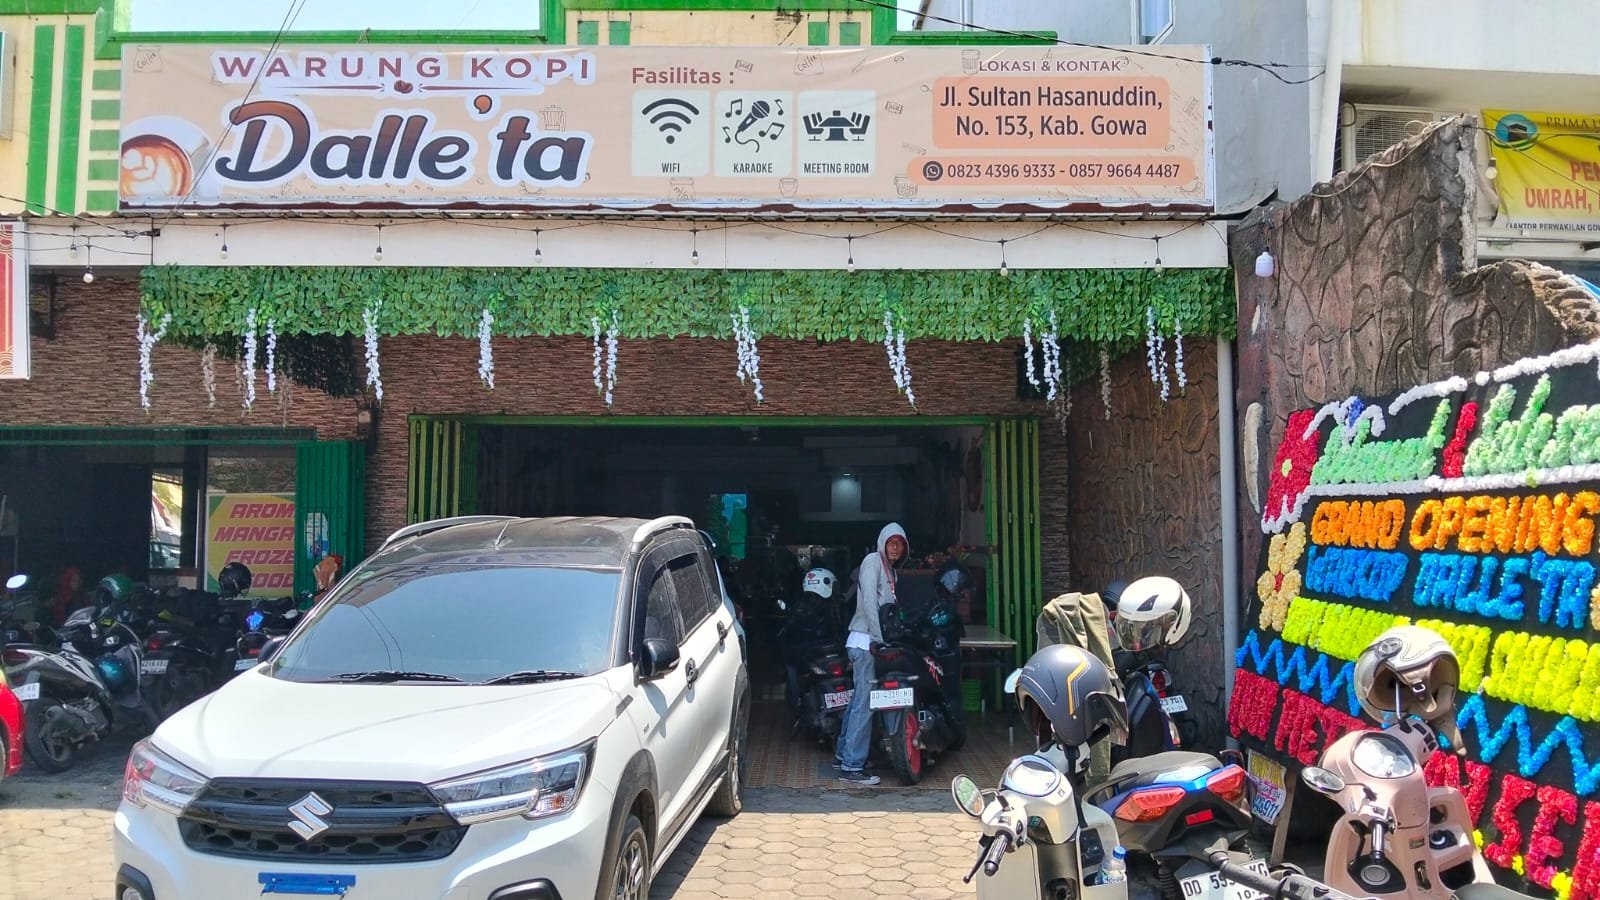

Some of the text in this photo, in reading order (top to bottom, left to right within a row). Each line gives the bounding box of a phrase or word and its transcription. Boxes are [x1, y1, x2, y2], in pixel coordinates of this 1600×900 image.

[219, 57, 588, 79] WARUNG KOPI
[979, 60, 1121, 72] LOKASI & KONTAK
[632, 67, 722, 85] Fasilitas
[940, 86, 1163, 109] Jl. Sultan Hasanuddin,
[956, 115, 1147, 139] No. 153, Kab. Gowa
[1546, 116, 1589, 128] PRIMA
[661, 162, 680, 173] WIFI
[733, 162, 773, 173] KARAOKE
[803, 162, 869, 174] MEETING ROOM
[947, 163, 981, 178] 0823
[985, 163, 1019, 178] 4396
[1023, 163, 1056, 178] 9333
[1069, 163, 1102, 178] 0857
[1107, 163, 1142, 178] 9664
[1145, 163, 1180, 178] 4487
[1524, 188, 1592, 214] UMRAH,
[1539, 223, 1586, 232] PERWAKILAN
[1409, 490, 1600, 556] OPENING
